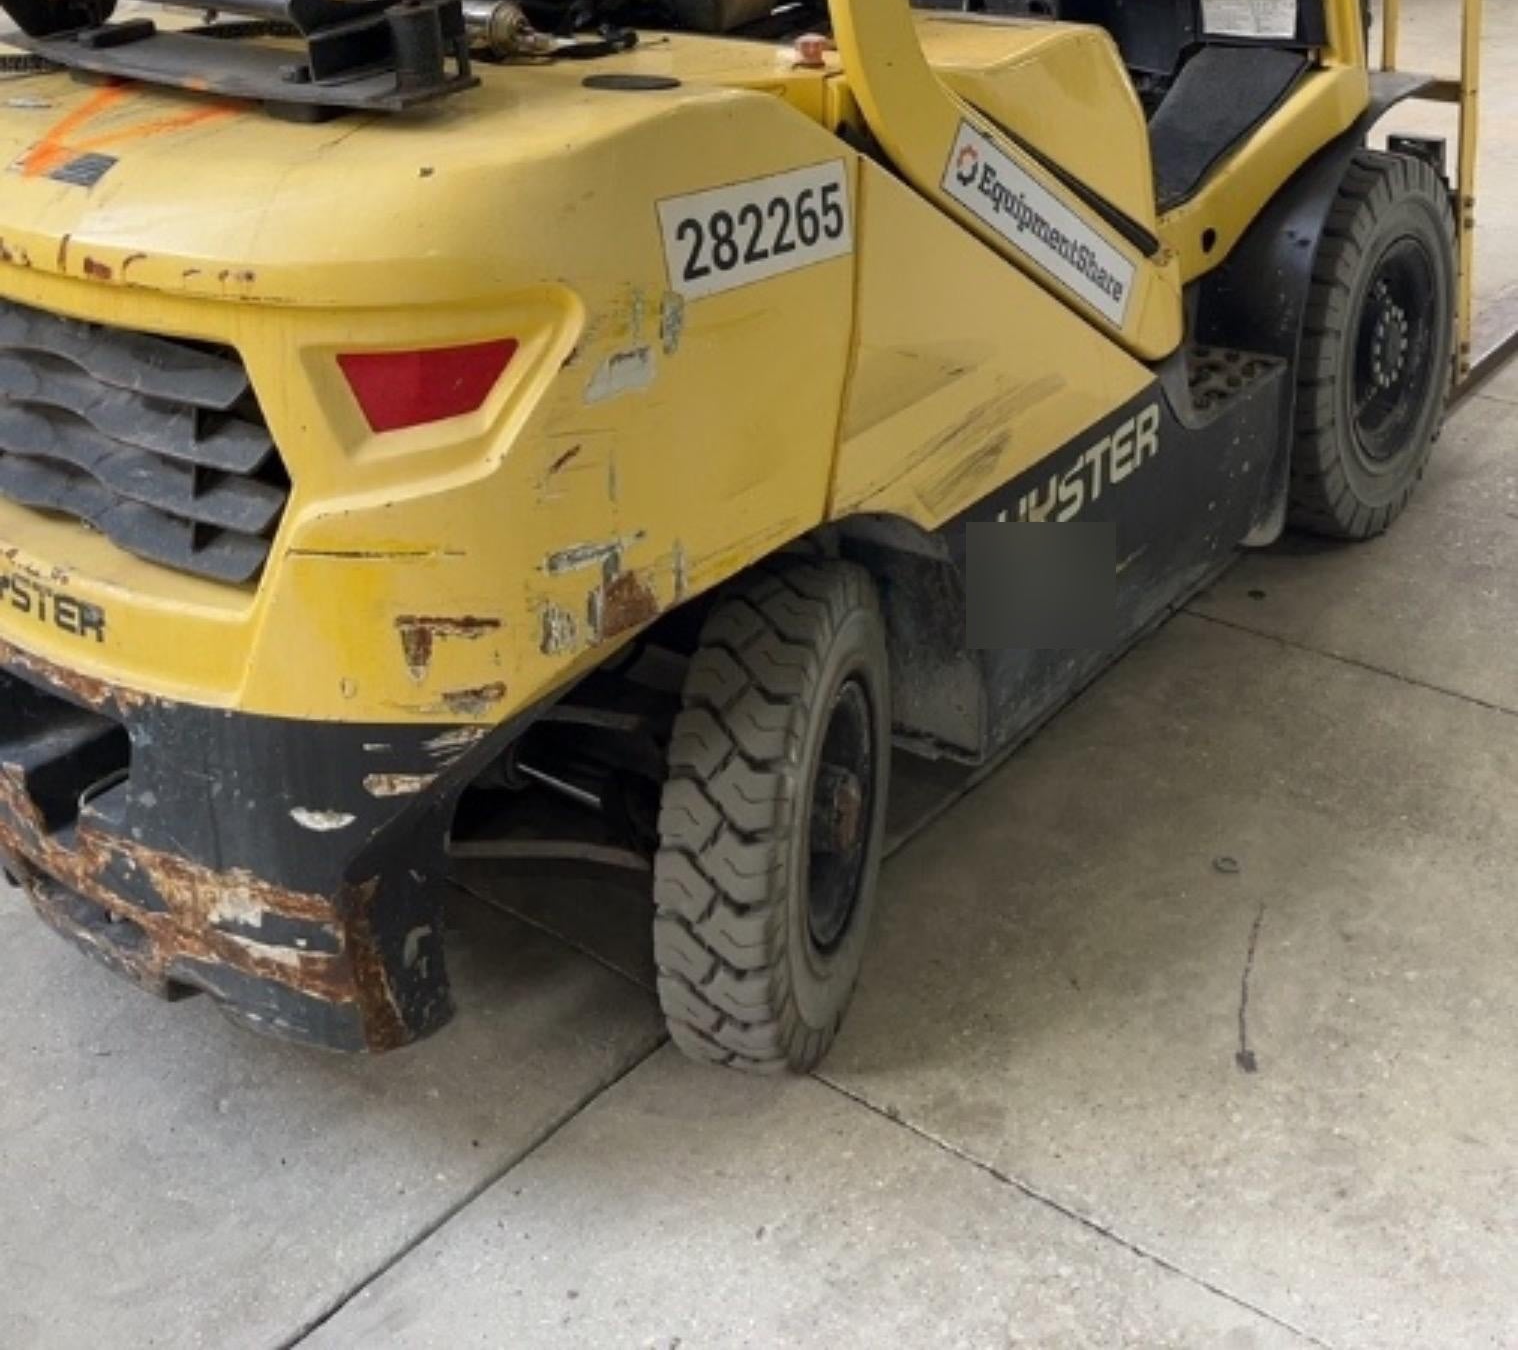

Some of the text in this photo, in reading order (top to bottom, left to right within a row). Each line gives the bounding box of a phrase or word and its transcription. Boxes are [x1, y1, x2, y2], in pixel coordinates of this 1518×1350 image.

[674, 182, 844, 282] 282265
[976, 162, 1125, 302] EquipmentShare
[997, 402, 1160, 523] YSTER
